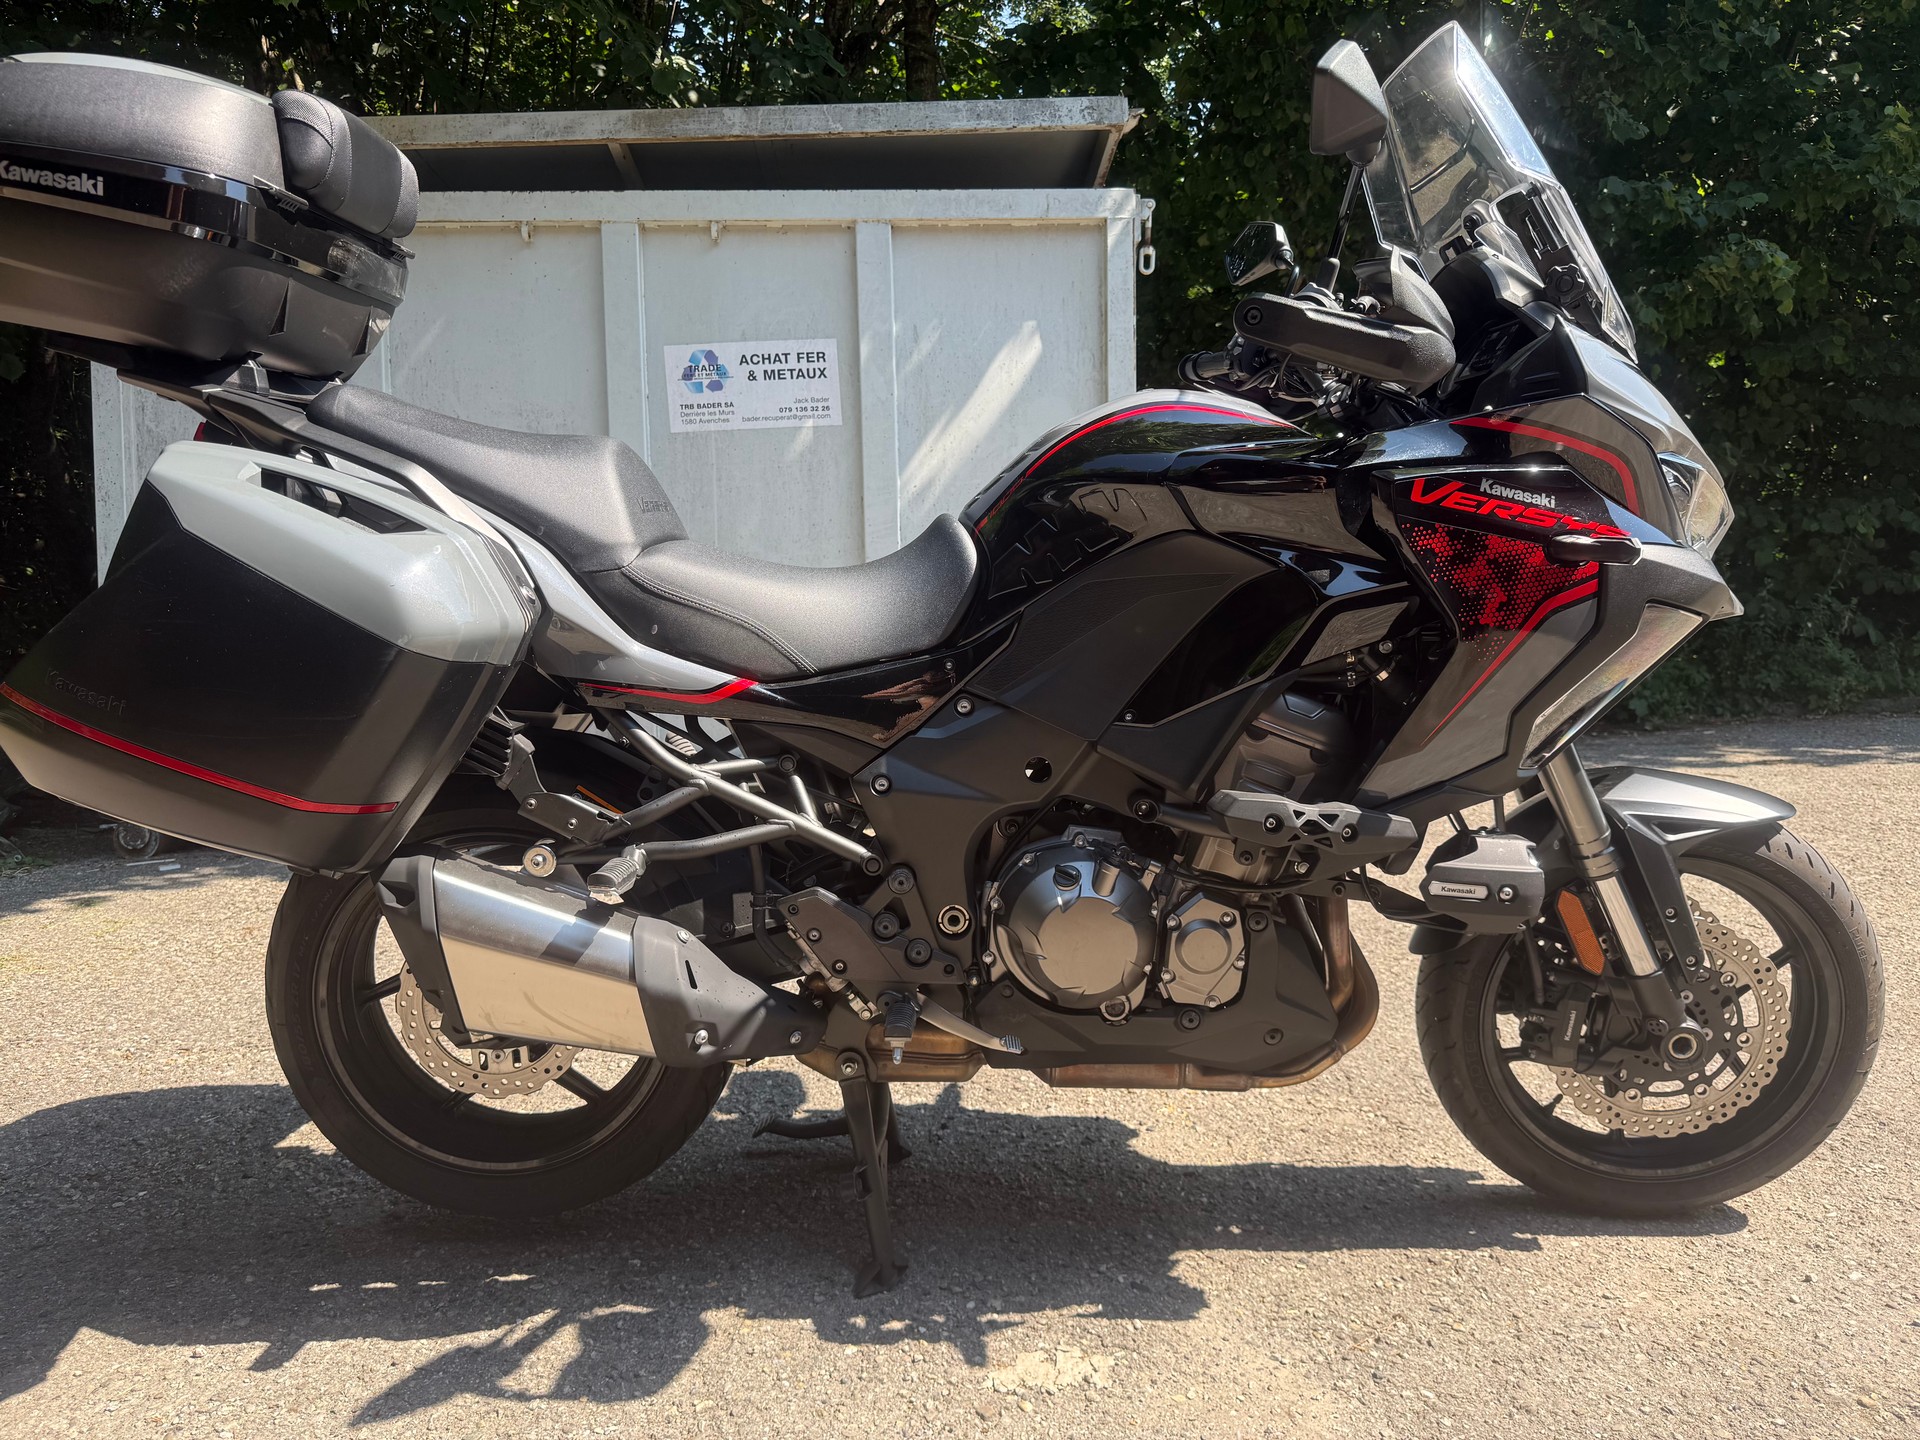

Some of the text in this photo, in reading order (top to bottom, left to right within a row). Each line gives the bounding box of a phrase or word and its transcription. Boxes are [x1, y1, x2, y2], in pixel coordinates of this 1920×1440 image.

[739, 351, 827, 366] ACHAT FER
[687, 363, 722, 373] TRADE
[747, 366, 828, 382] & METAUX
[810, 396, 830, 404] Bader
[680, 403, 695, 411] TRB
[696, 402, 723, 410] BADER
[779, 406, 793, 414] 079
[1479, 478, 1556, 509] Kawasaki
[1411, 477, 1632, 539] VERSYS
[1440, 886, 1476, 895] Kawasaki
[1563, 1010, 1576, 1041] Kawasaki
